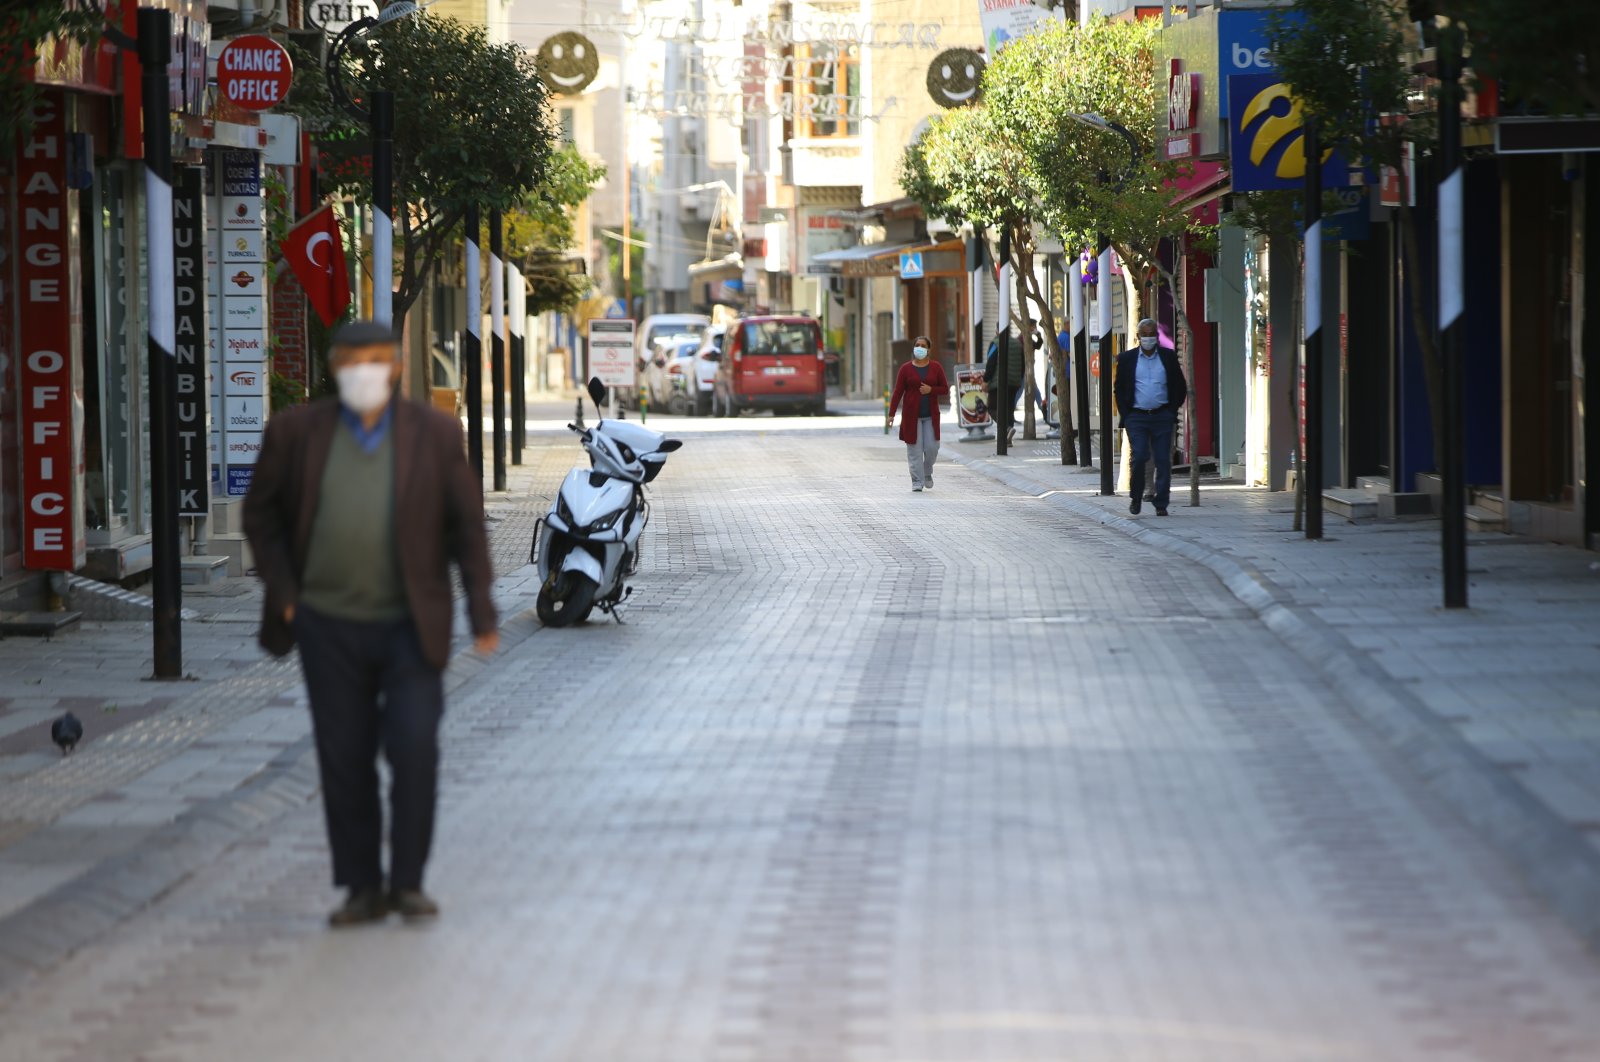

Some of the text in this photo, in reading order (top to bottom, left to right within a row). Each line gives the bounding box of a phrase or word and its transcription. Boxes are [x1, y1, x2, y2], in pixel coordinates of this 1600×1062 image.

[224, 47, 281, 72] CHANGE
[228, 79, 278, 101] OFFICE
[24, 101, 61, 302] CHANGE
[27, 350, 64, 550] OFFICE
